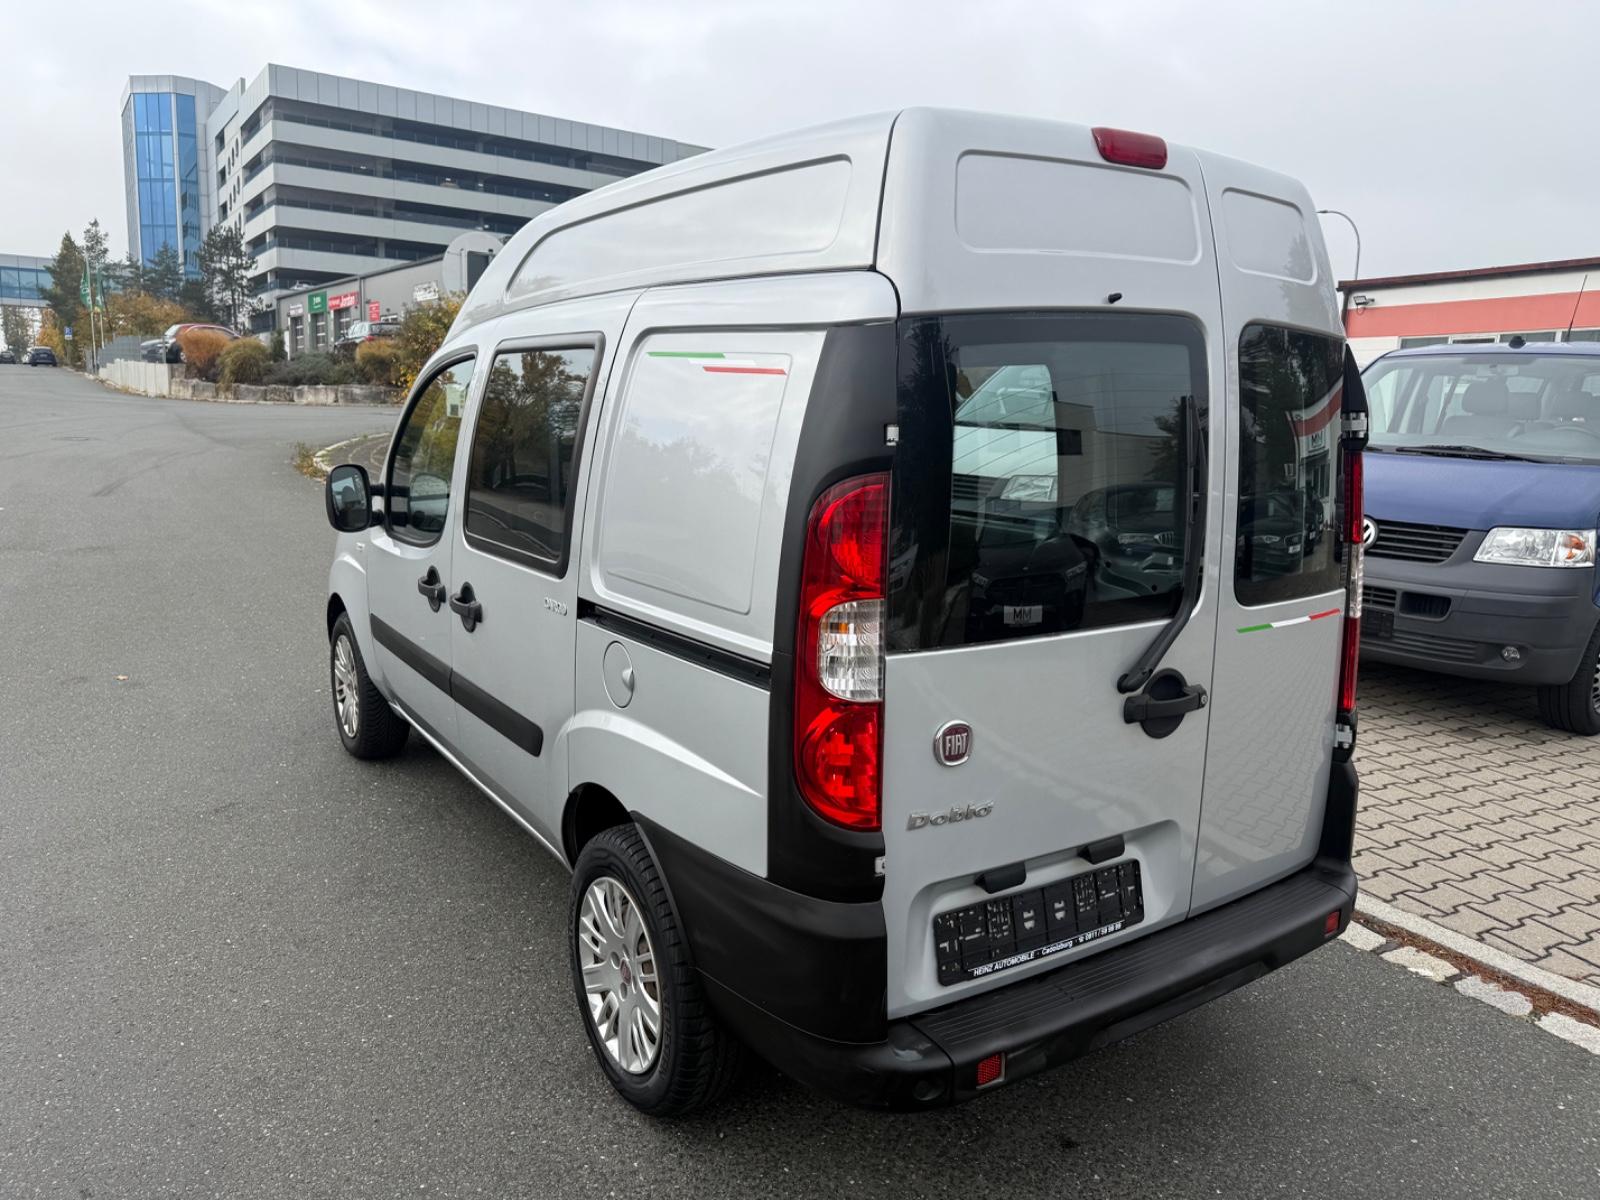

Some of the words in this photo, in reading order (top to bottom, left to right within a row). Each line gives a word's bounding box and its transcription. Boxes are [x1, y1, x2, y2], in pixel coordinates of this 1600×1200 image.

[945, 732, 968, 757] FIAT
[973, 966, 993, 977] HEINZ
[994, 951, 1035, 970] AUTOMOBILE
